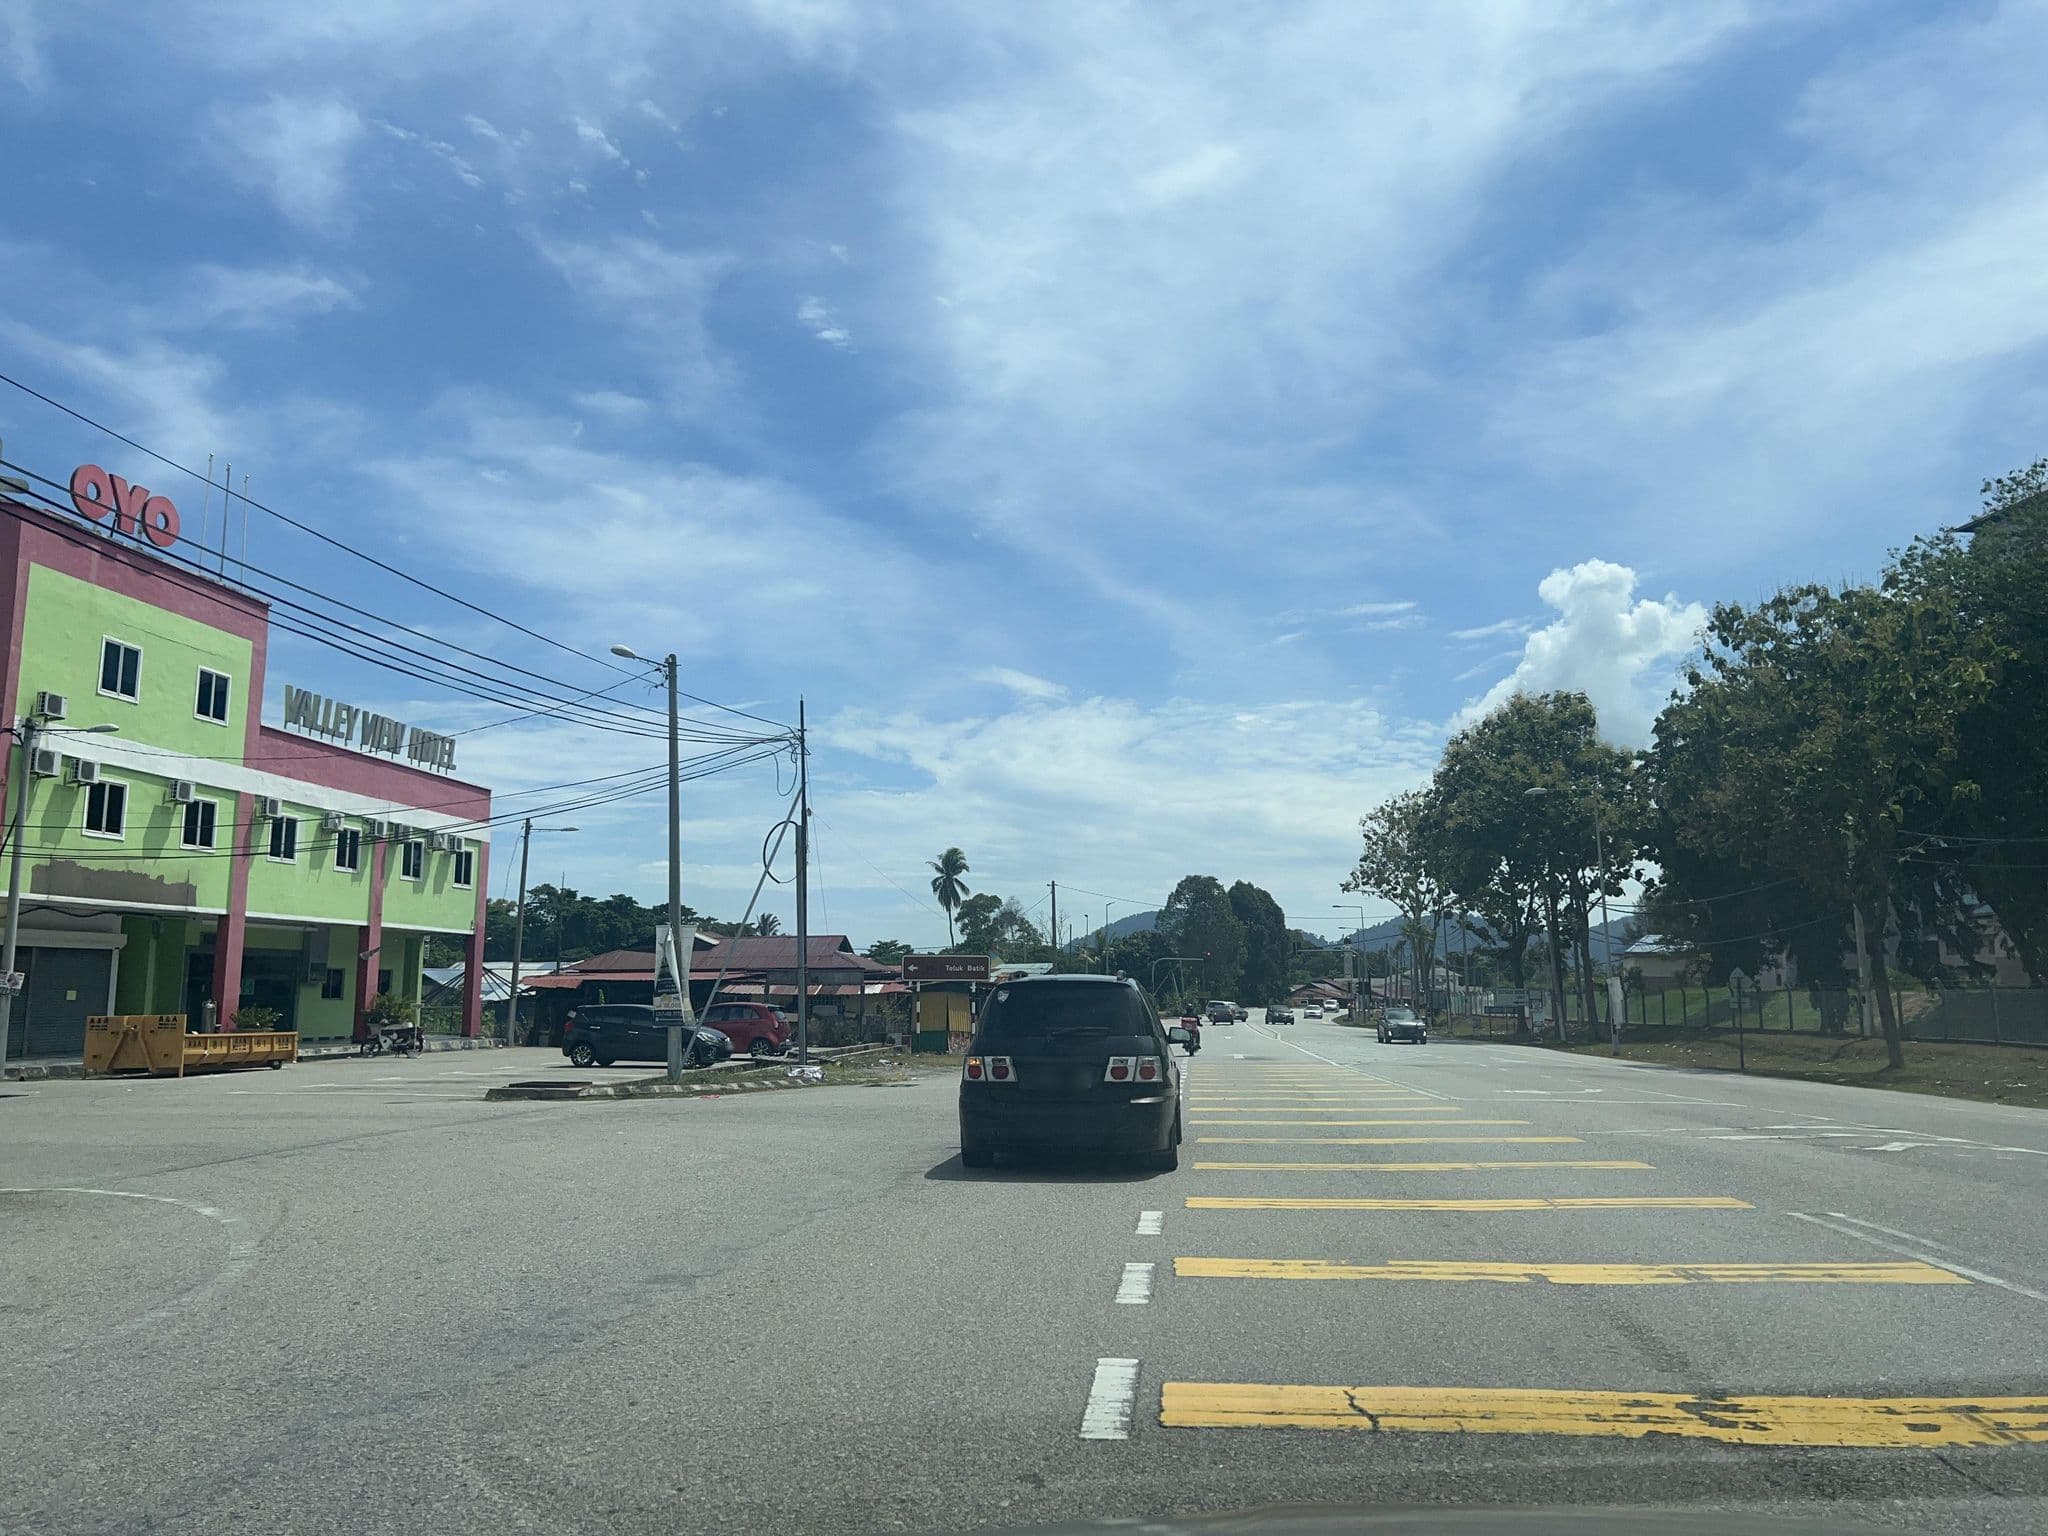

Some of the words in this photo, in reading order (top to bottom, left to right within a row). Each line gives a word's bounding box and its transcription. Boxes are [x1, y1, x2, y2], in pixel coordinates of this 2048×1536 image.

[70, 464, 180, 547] OYO
[284, 684, 361, 741] VALLEY
[361, 710, 407, 755] VIEW
[407, 727, 457, 771] HOTEL
[944, 964, 963, 972] Teluk
[967, 964, 985, 972] Batik
